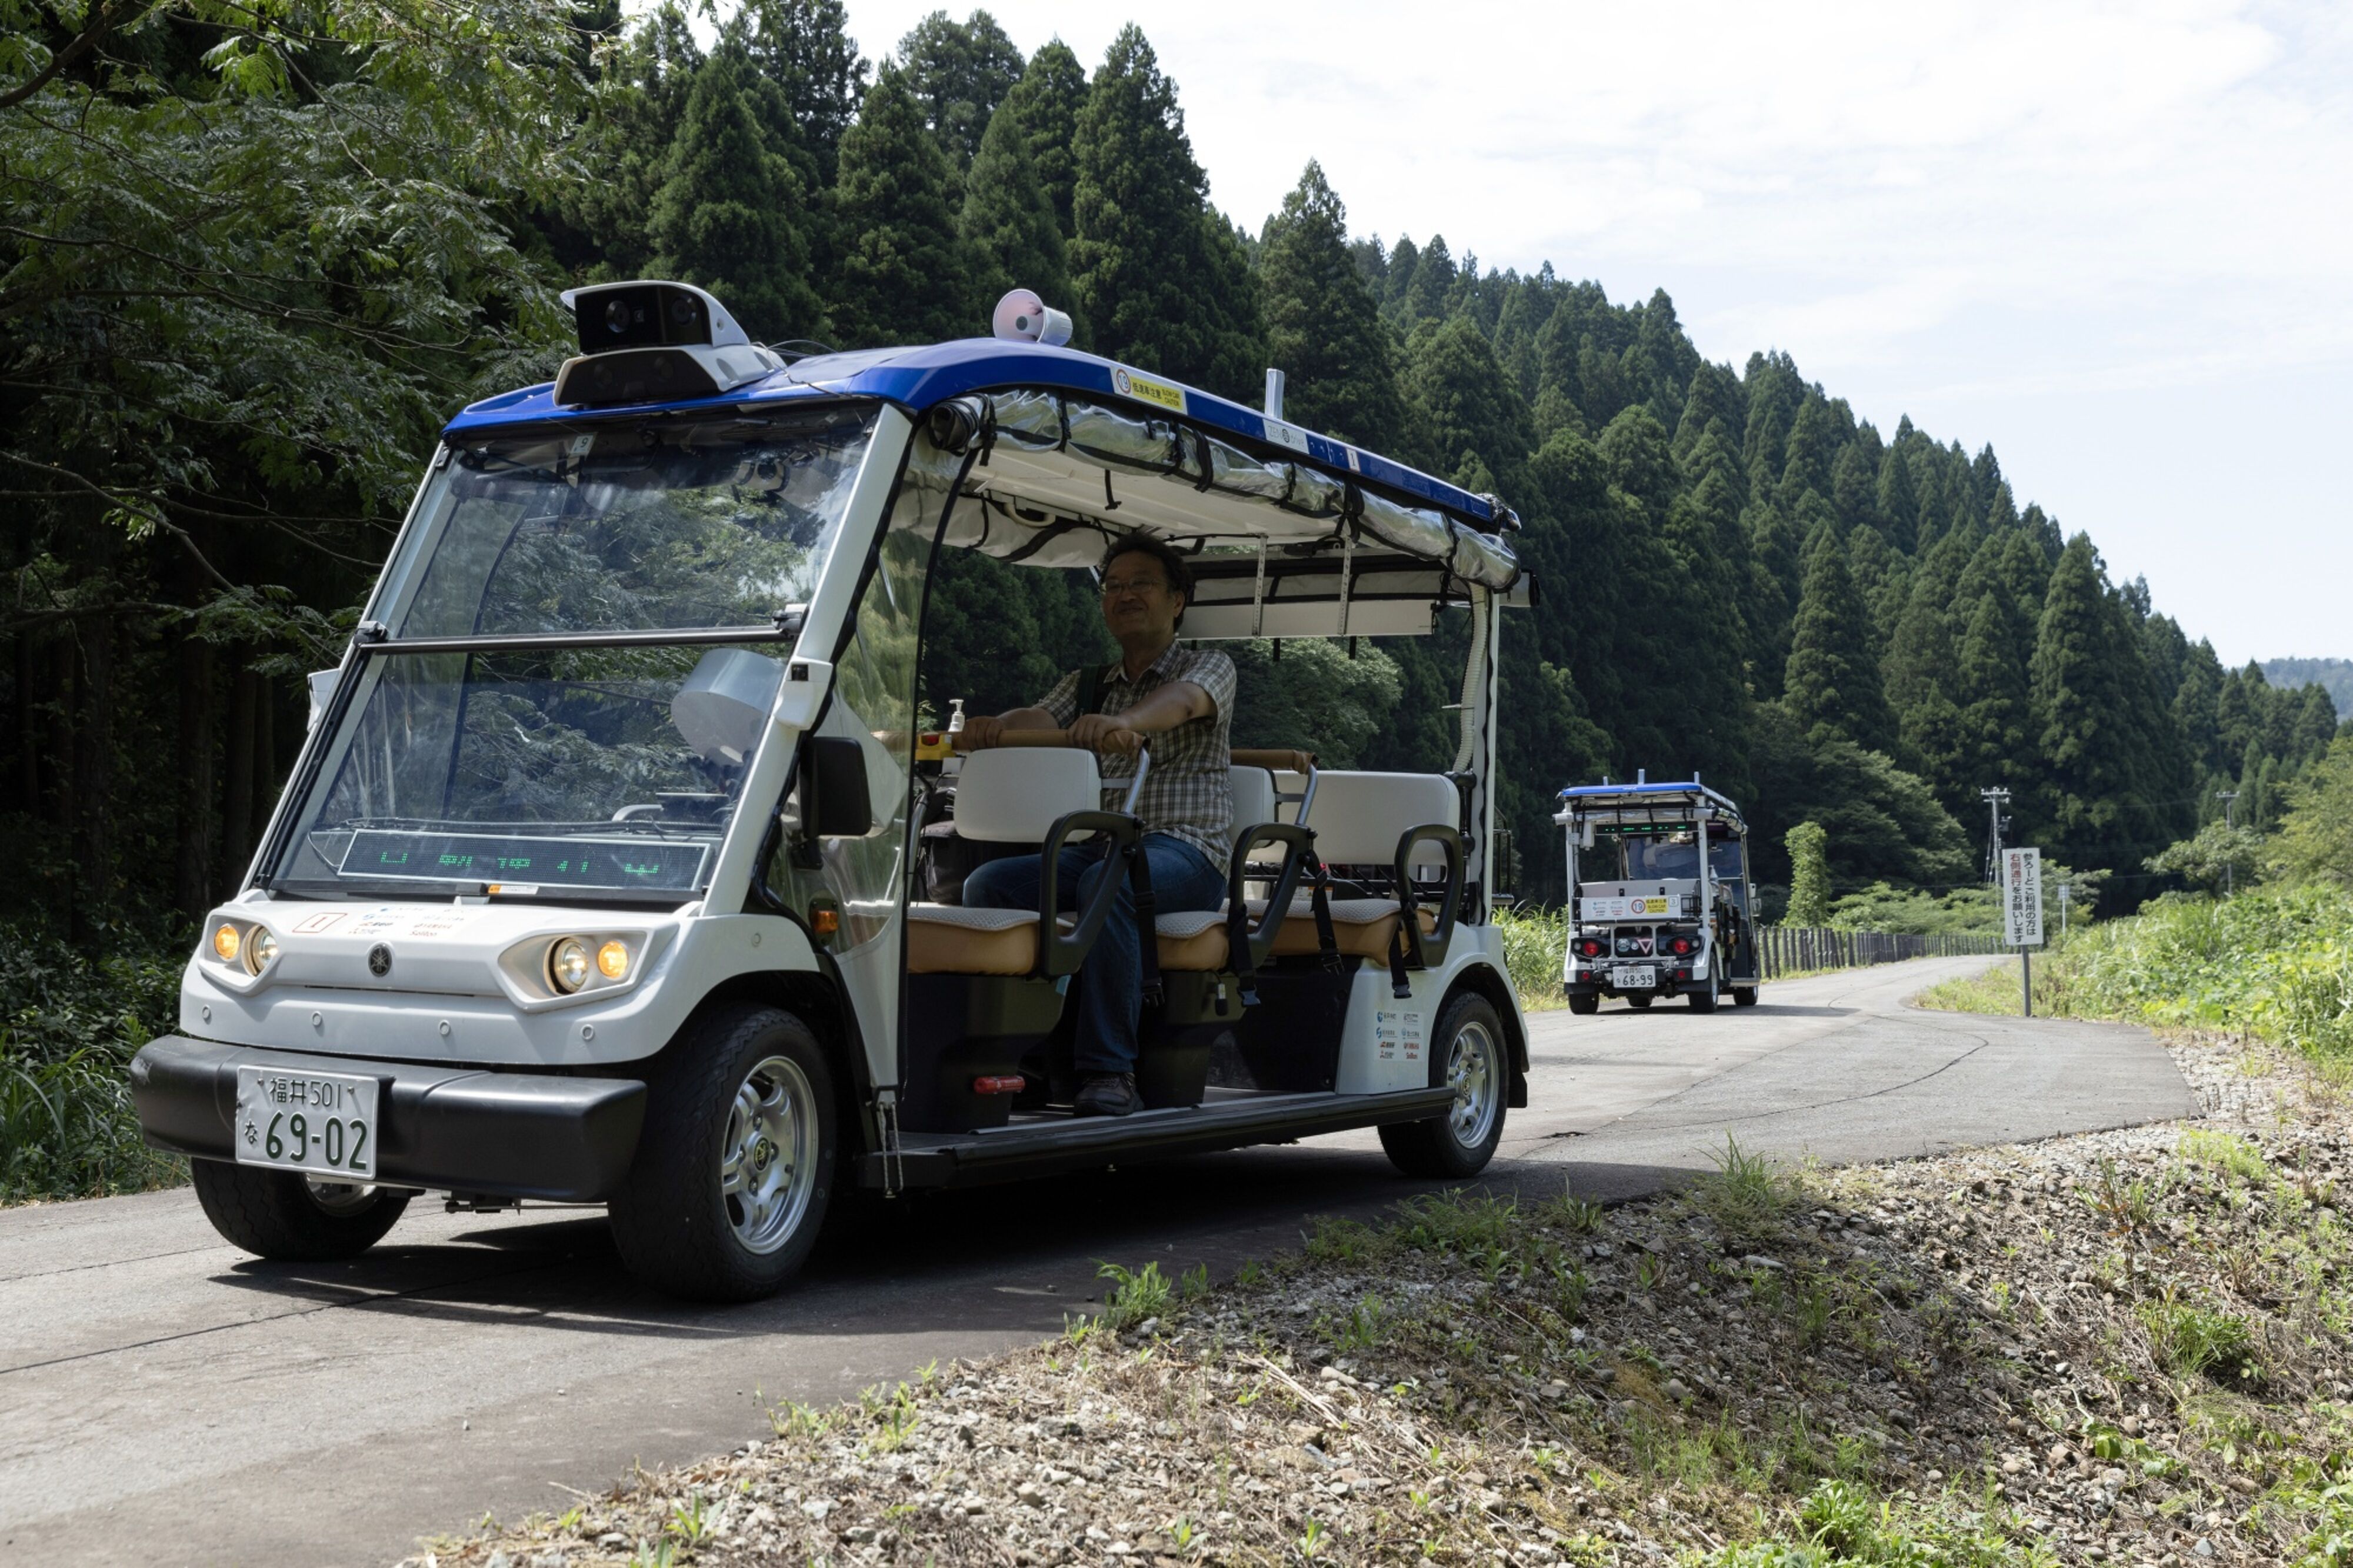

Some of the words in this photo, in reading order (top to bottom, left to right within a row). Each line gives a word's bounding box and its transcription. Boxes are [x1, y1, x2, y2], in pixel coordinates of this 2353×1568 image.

[1119, 374, 1128, 389] 19
[1350, 453, 1356, 466] 1
[2010, 853, 2024, 943] 右側通行をお願いします
[1634, 903, 1643, 911] 19
[1622, 975, 1654, 986] 68-99
[269, 1076, 341, 1109] 福井501
[244, 1119, 258, 1145] な
[266, 1110, 368, 1170] 69-02
